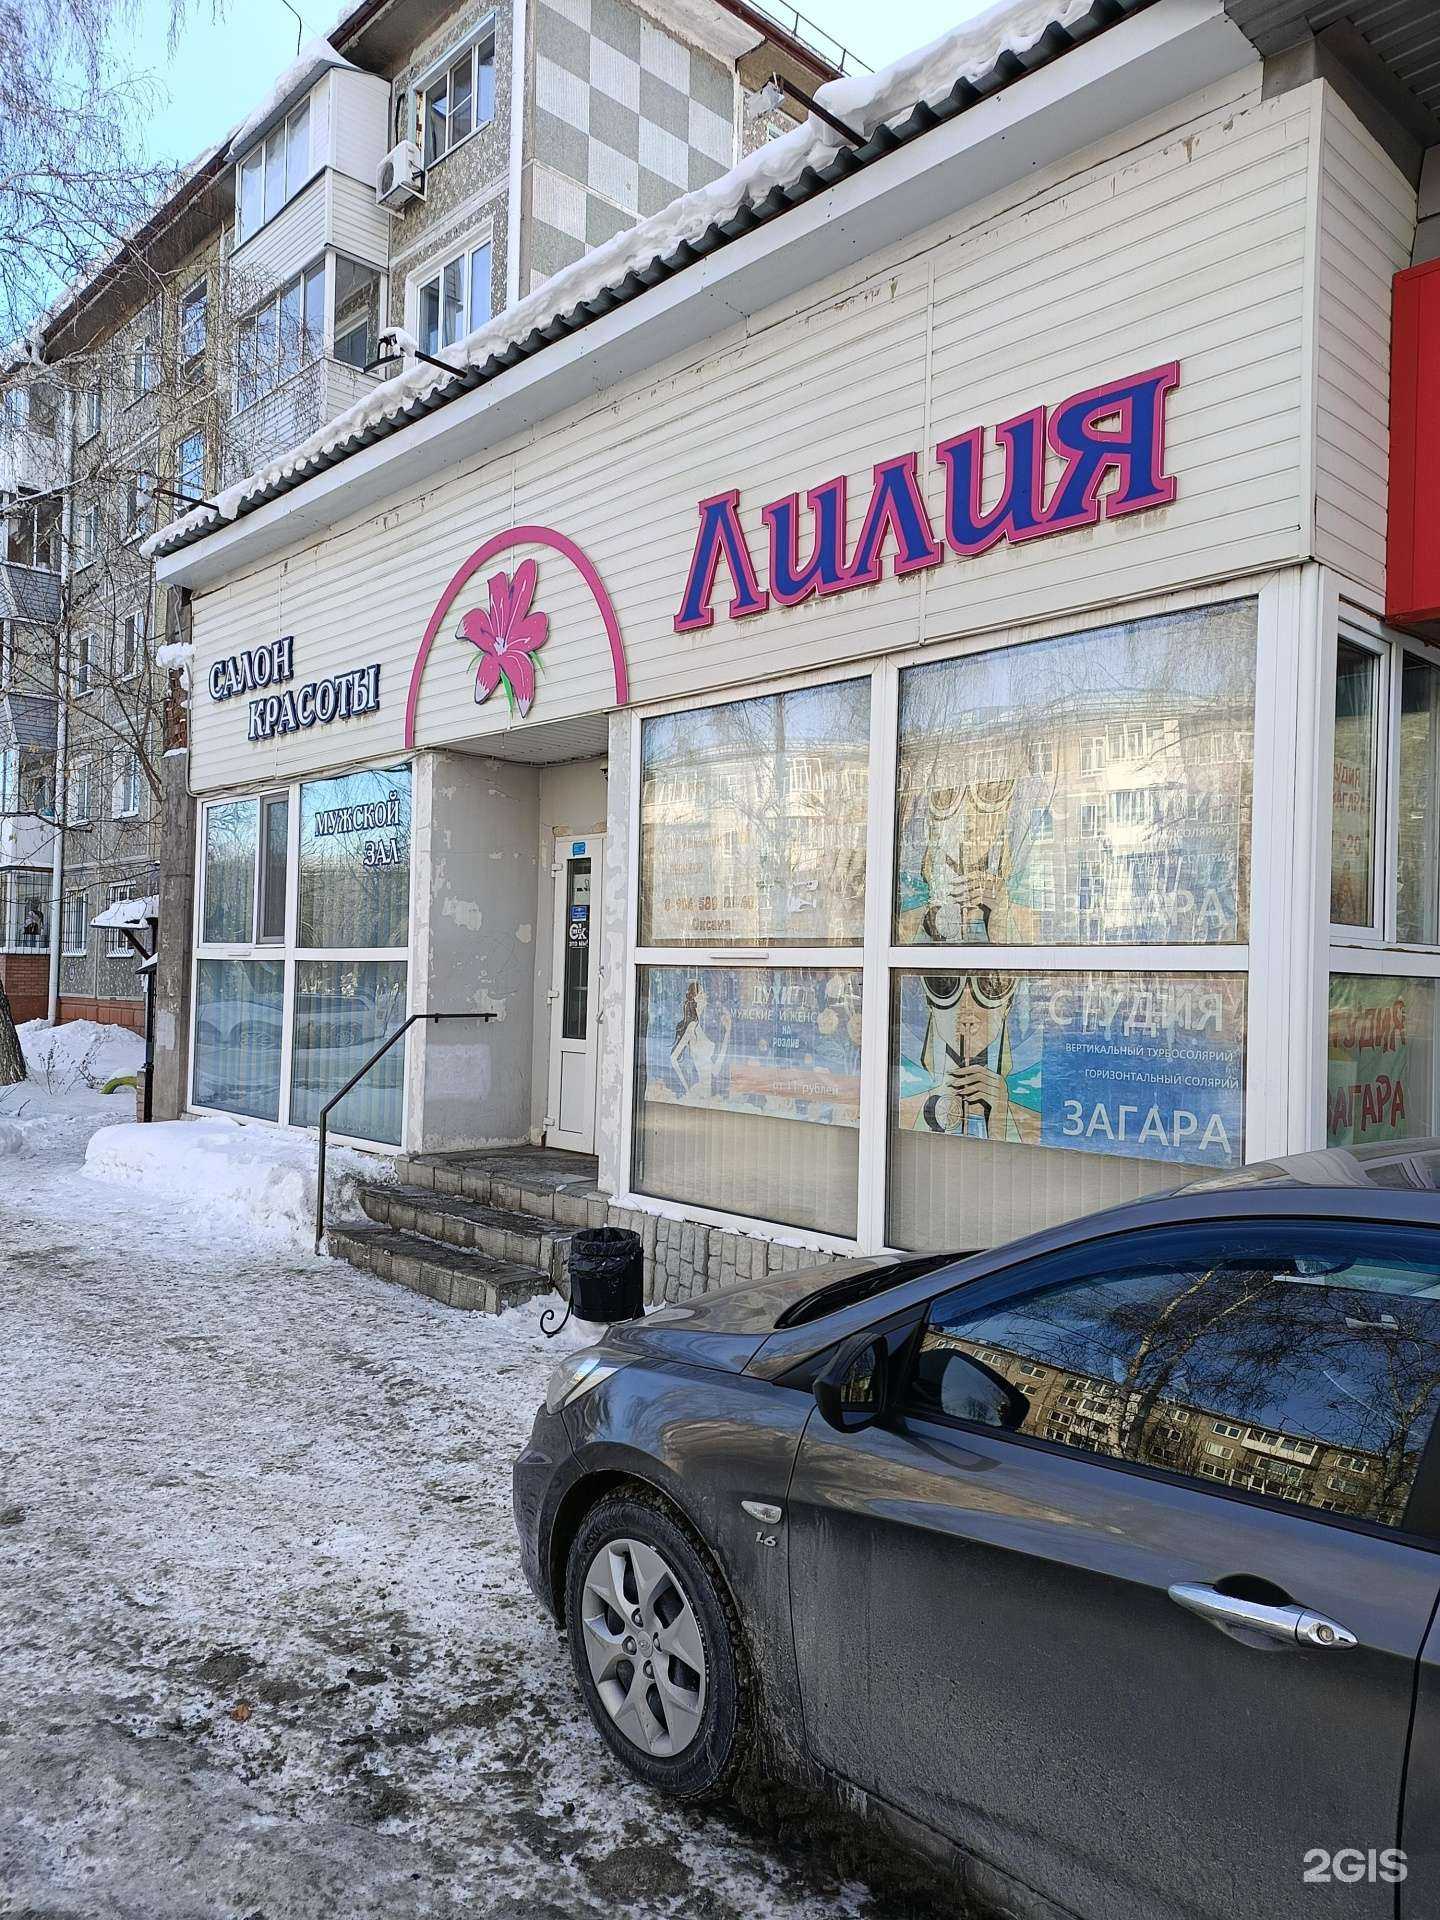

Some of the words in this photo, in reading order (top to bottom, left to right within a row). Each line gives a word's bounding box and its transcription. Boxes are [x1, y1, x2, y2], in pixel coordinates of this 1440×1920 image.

[208, 636, 294, 701] САЛОН
[248, 664, 381, 741] КРАСОТЫ
[314, 790, 401, 837] МУЖСКОЙ
[363, 838, 401, 867] ЗАЛ
[1049, 989, 1223, 1039] СТУДИЯ
[1065, 1043, 1144, 1057] ВЕРТИКАЛЬНЫЙ
[1147, 1048, 1234, 1062] ТУРБОСОЛЯРИЙ
[1085, 1068, 1182, 1085] ГОРИЗОНТАЛЬНЫЙ
[1184, 1075, 1239, 1089] СОЛЯРИЙ
[1062, 1100, 1232, 1154] ЗАГАРА
